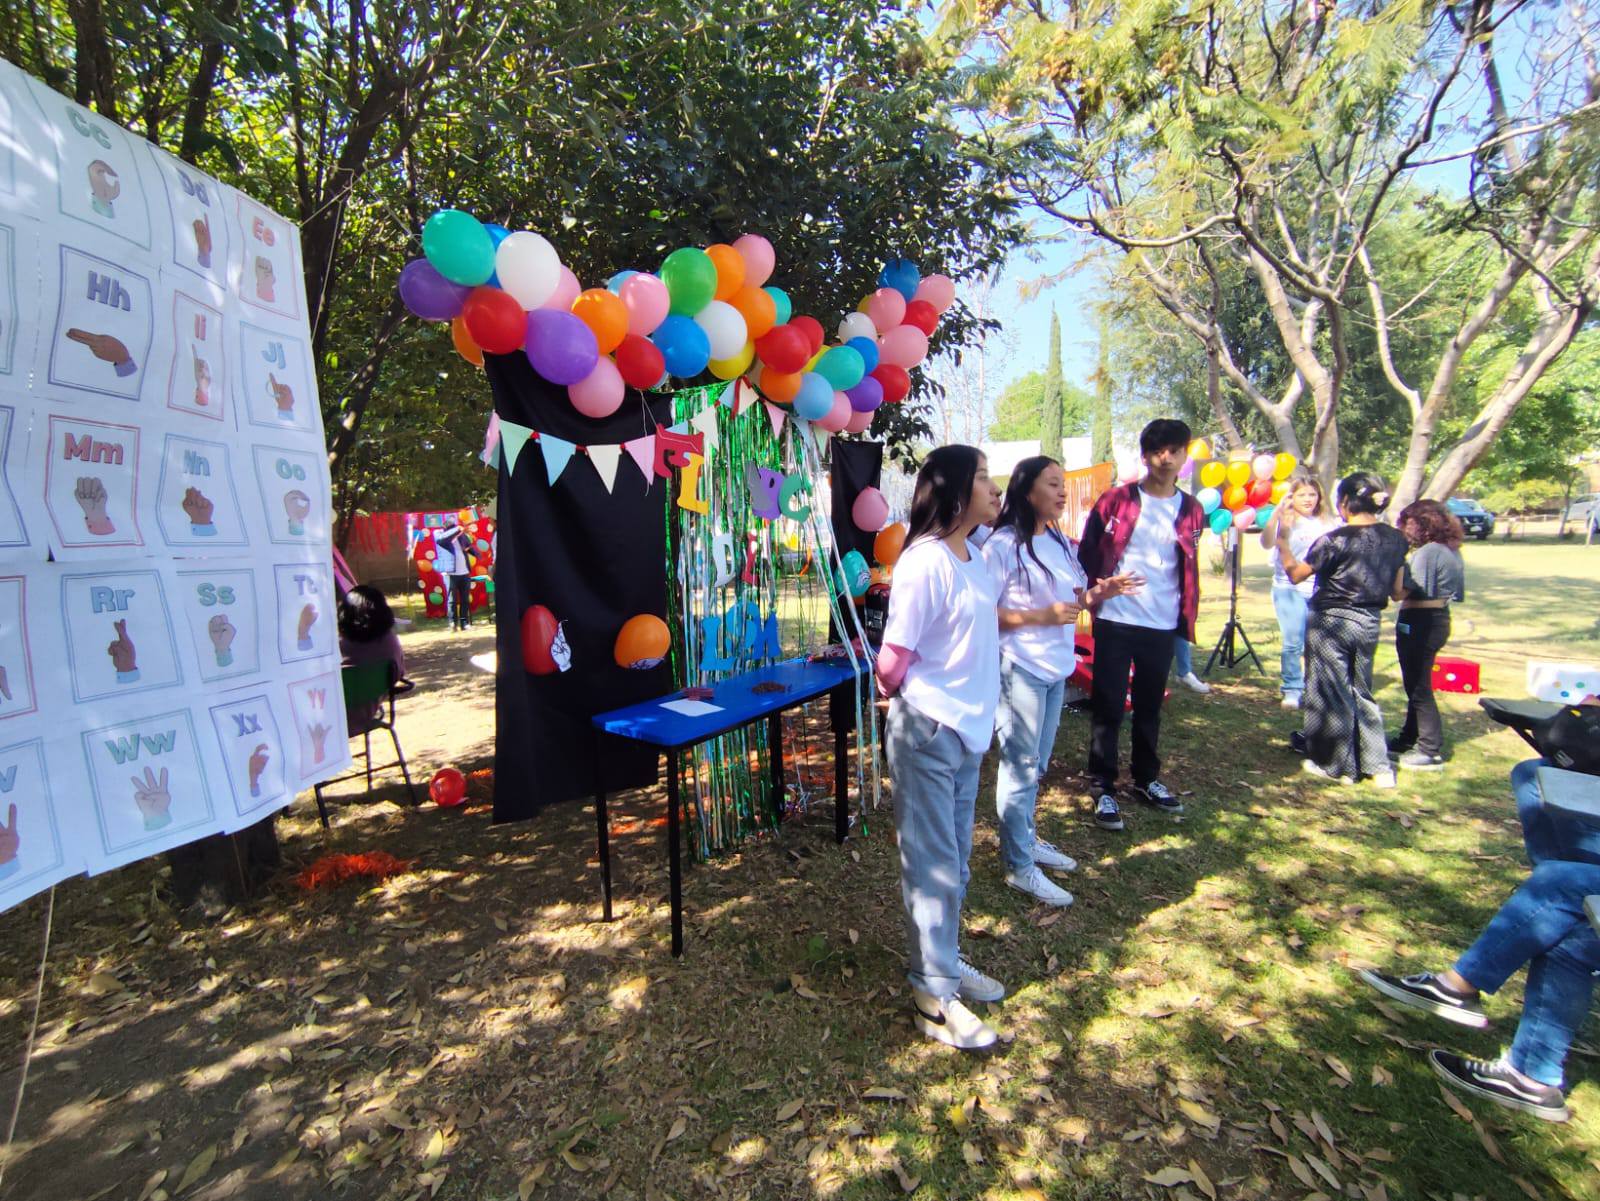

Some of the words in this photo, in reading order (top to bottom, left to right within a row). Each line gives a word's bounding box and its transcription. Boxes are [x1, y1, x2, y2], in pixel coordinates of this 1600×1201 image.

[66, 105, 112, 150] Cc
[253, 216, 276, 247] Ee
[86, 270, 132, 312] Hh
[261, 341, 287, 370] Jj
[63, 432, 124, 466] Mm
[183, 449, 211, 477] Nn
[275, 458, 307, 482] Oo
[90, 585, 136, 614] Rr
[196, 582, 236, 607] Ss
[293, 574, 319, 596] Tt
[307, 687, 326, 710] Yy
[231, 712, 263, 738] Xx
[104, 729, 177, 765] Ww
